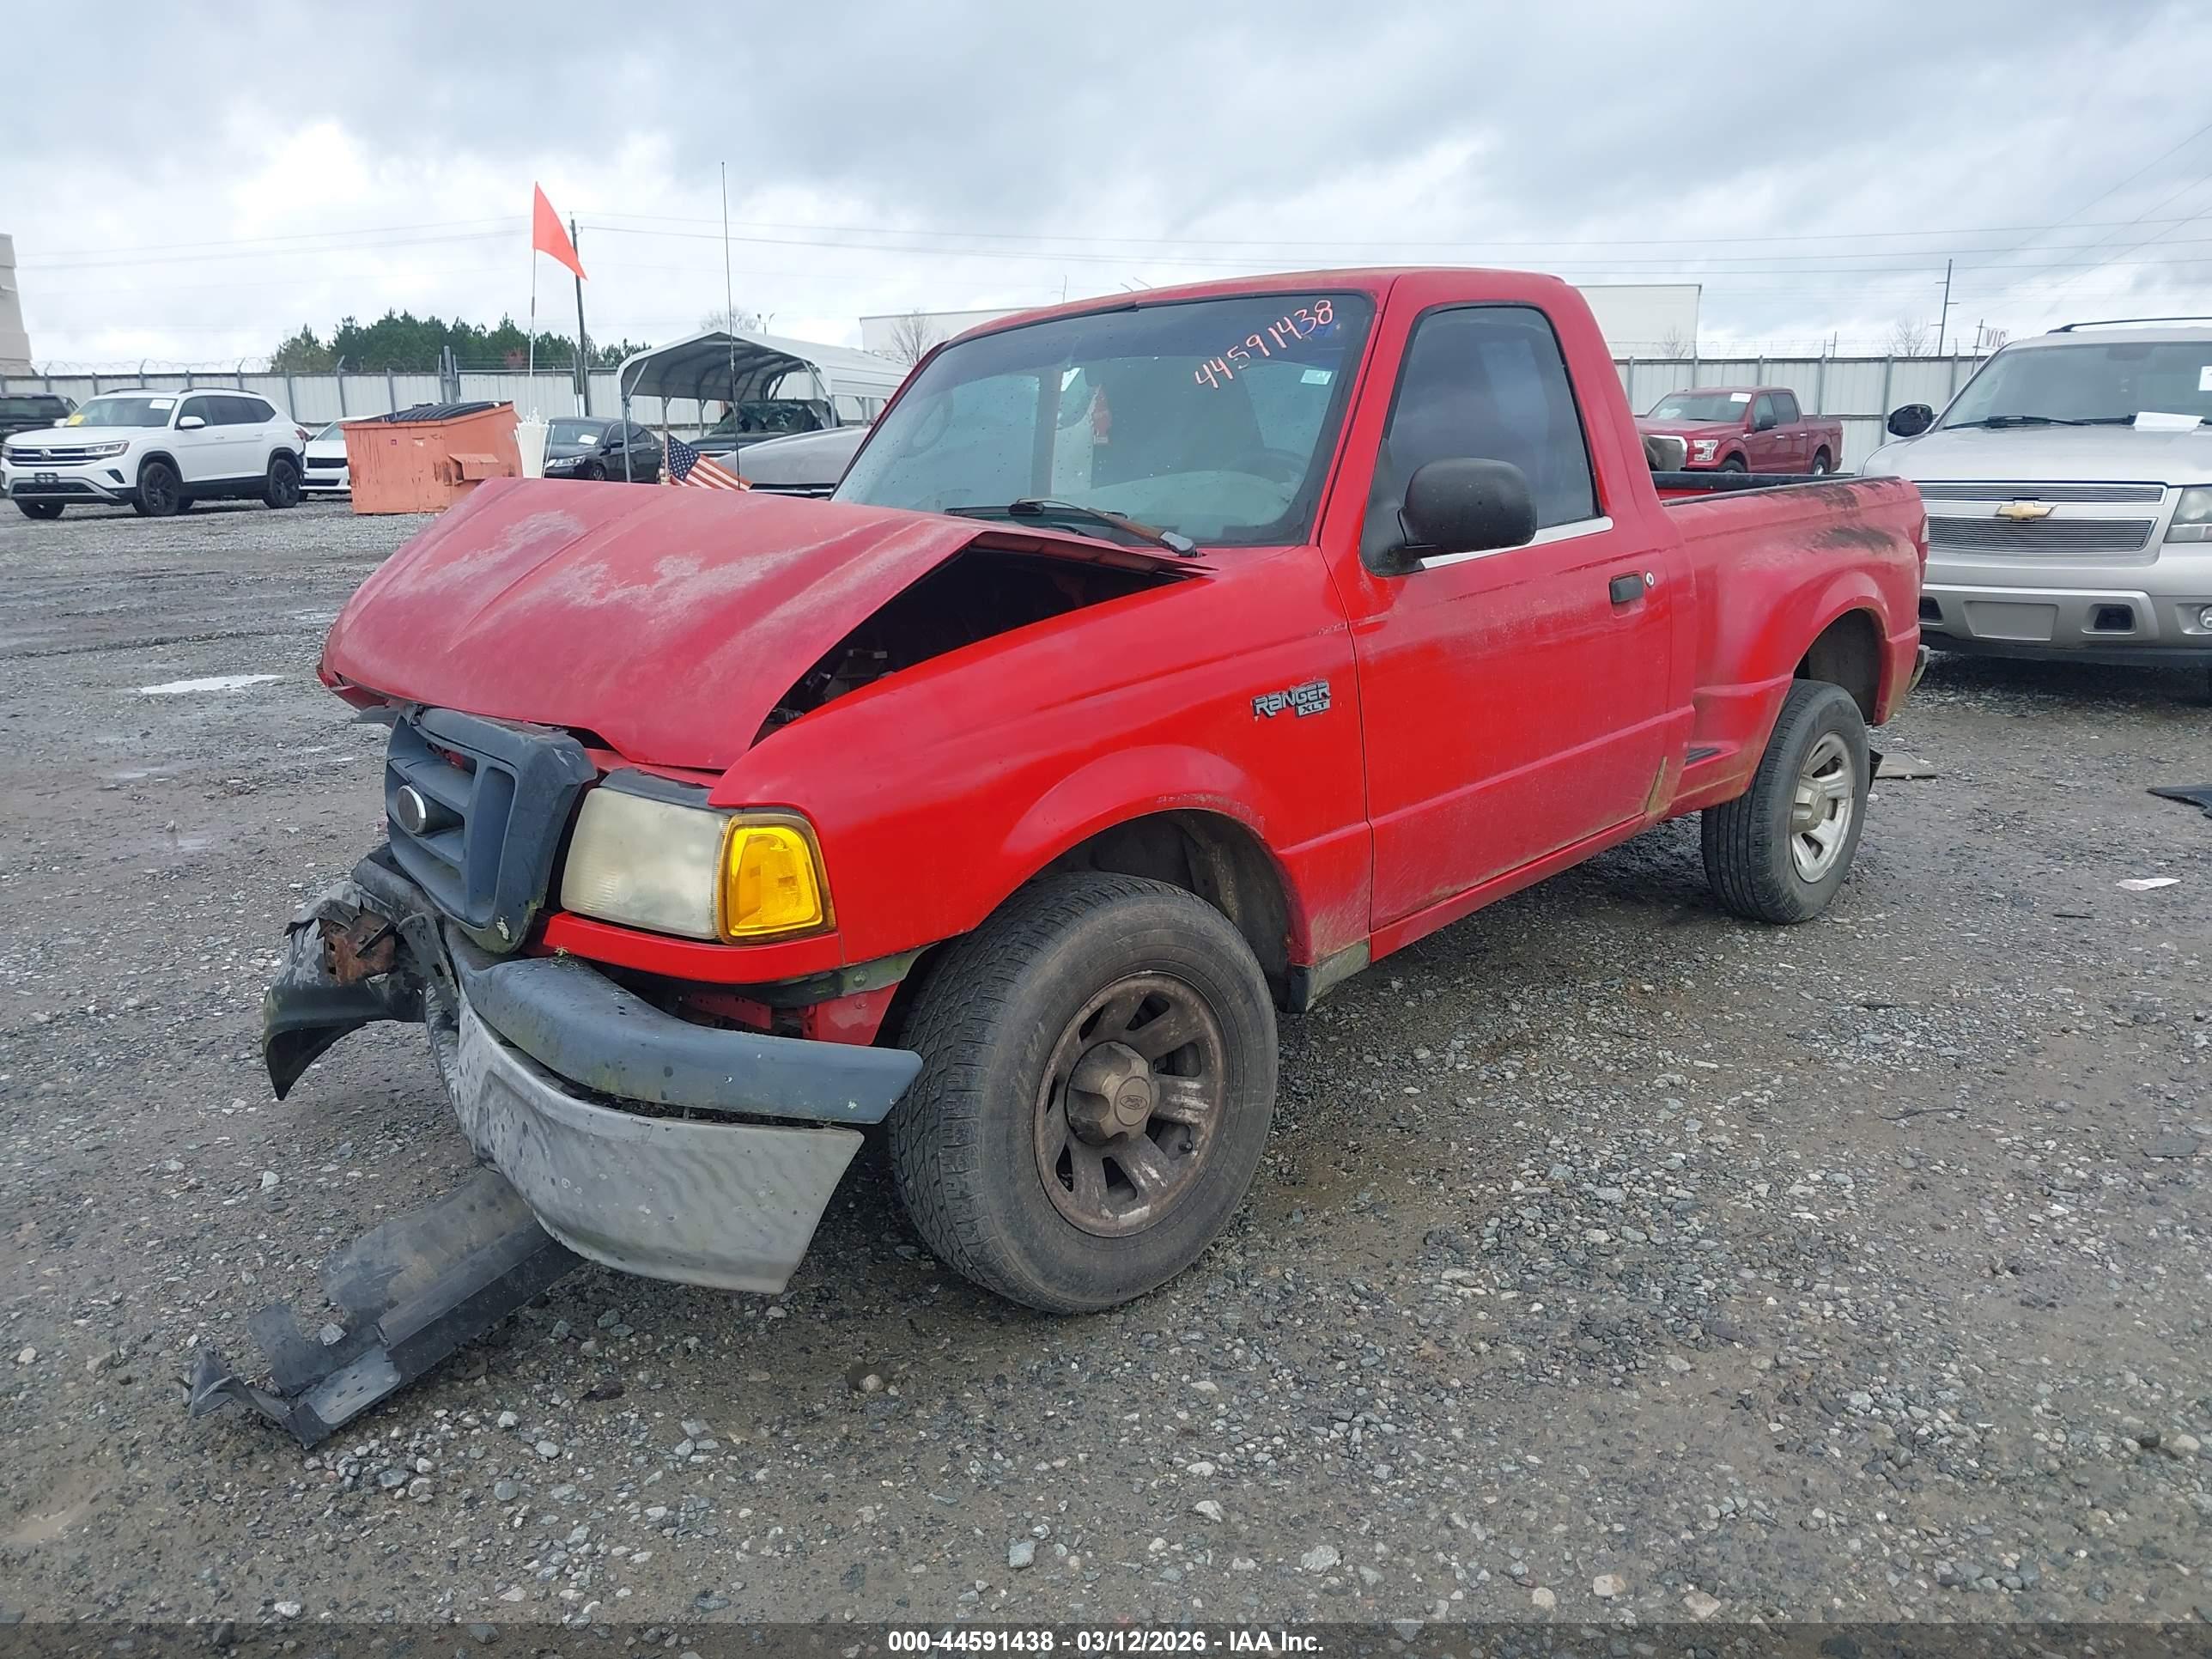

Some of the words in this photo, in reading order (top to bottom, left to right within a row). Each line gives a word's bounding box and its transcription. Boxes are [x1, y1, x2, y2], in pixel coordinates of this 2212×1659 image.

[1194, 299, 1334, 389] 44591438
[1253, 681, 1331, 717] RANGER
[1302, 700, 1327, 714] XLT
